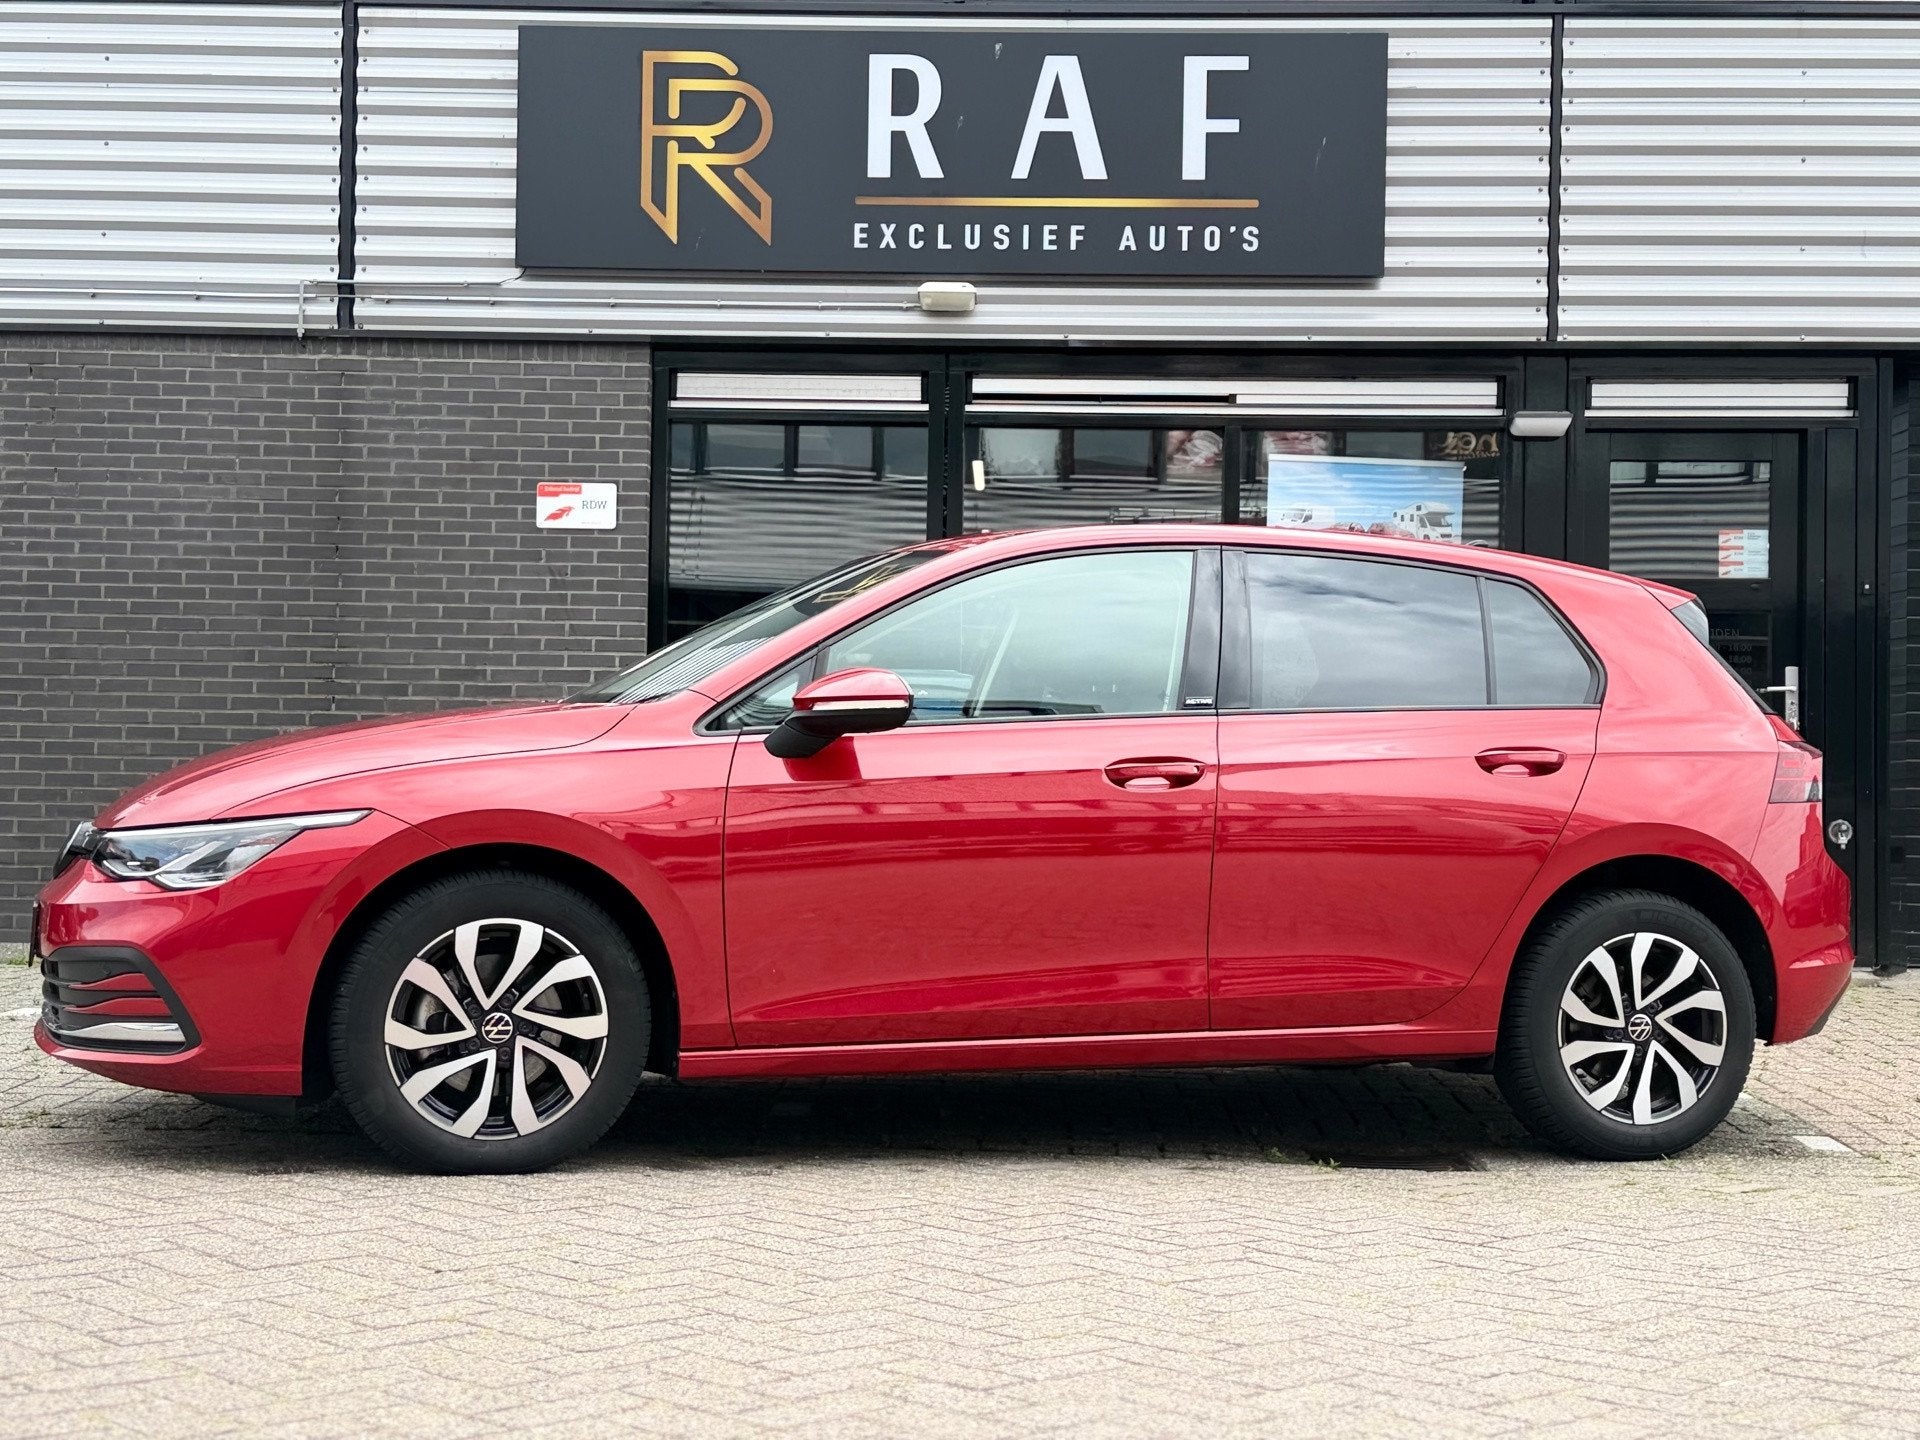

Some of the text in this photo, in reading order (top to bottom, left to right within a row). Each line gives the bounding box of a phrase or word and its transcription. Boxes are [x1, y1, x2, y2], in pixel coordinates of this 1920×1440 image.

[867, 53, 1250, 182] RAF
[853, 222, 1260, 252] EXCLUSIEF AUTO'S
[581, 500, 608, 510] RDW
